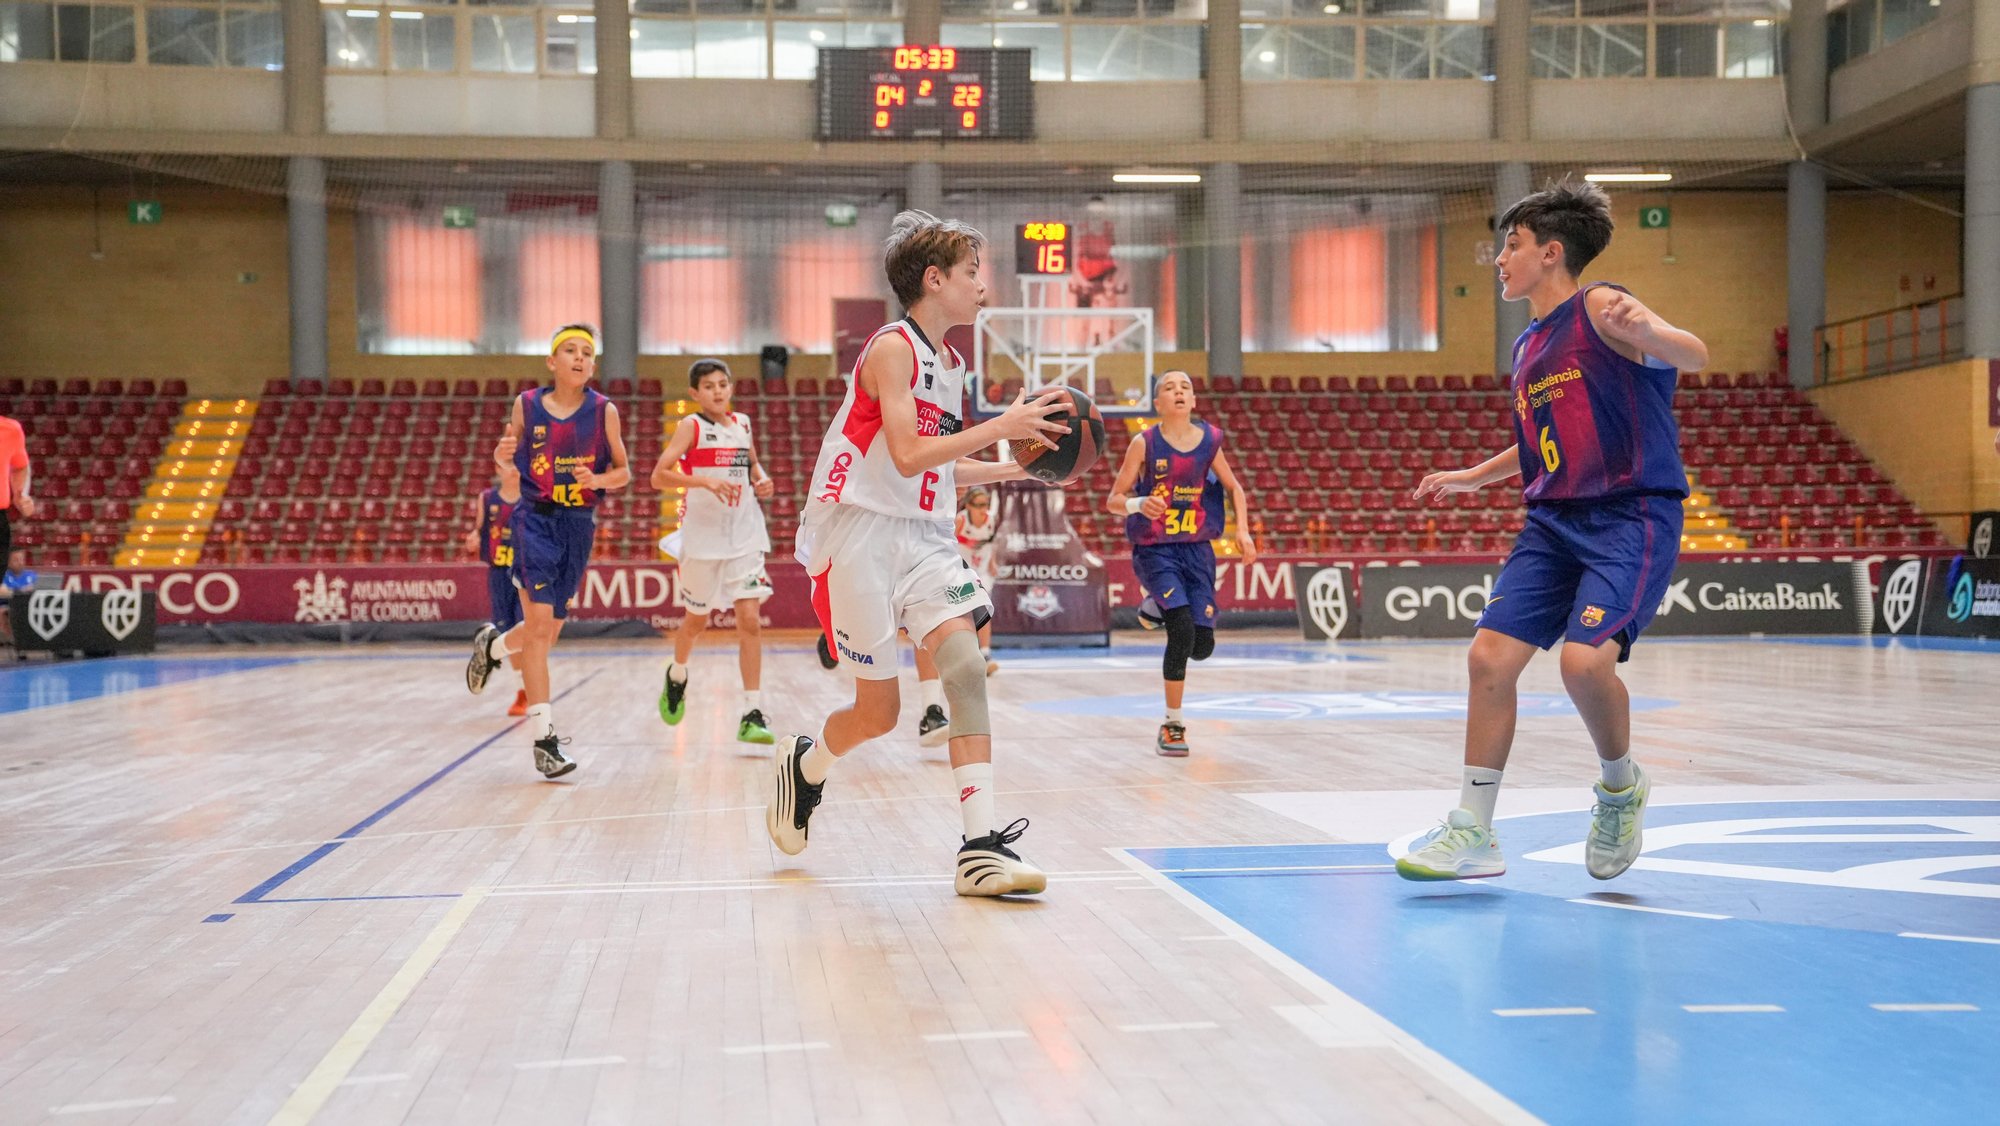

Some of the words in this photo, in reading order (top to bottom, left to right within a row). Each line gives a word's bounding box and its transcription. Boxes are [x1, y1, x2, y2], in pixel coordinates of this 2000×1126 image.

[894, 46, 955, 70] 05:33
[876, 85, 905, 107] 04
[918, 79, 933, 97] 2
[952, 85, 982, 107] 22
[136, 202, 153, 222] K
[1037, 244, 1065, 274] 16
[1528, 367, 1582, 397] Assistència
[1530, 387, 1565, 410] Santària
[1540, 425, 1560, 473] 6
[552, 483, 584, 506] 43
[919, 470, 940, 512] 6
[1165, 508, 1198, 535] 34
[1014, 564, 1088, 580] IMDECO
[351, 578, 458, 601] AYUNTAMIENTO
[1385, 573, 1493, 621] end
[1698, 582, 1843, 611] CaixaBank
[351, 601, 370, 622] DE
[837, 641, 874, 665] PULEVA
